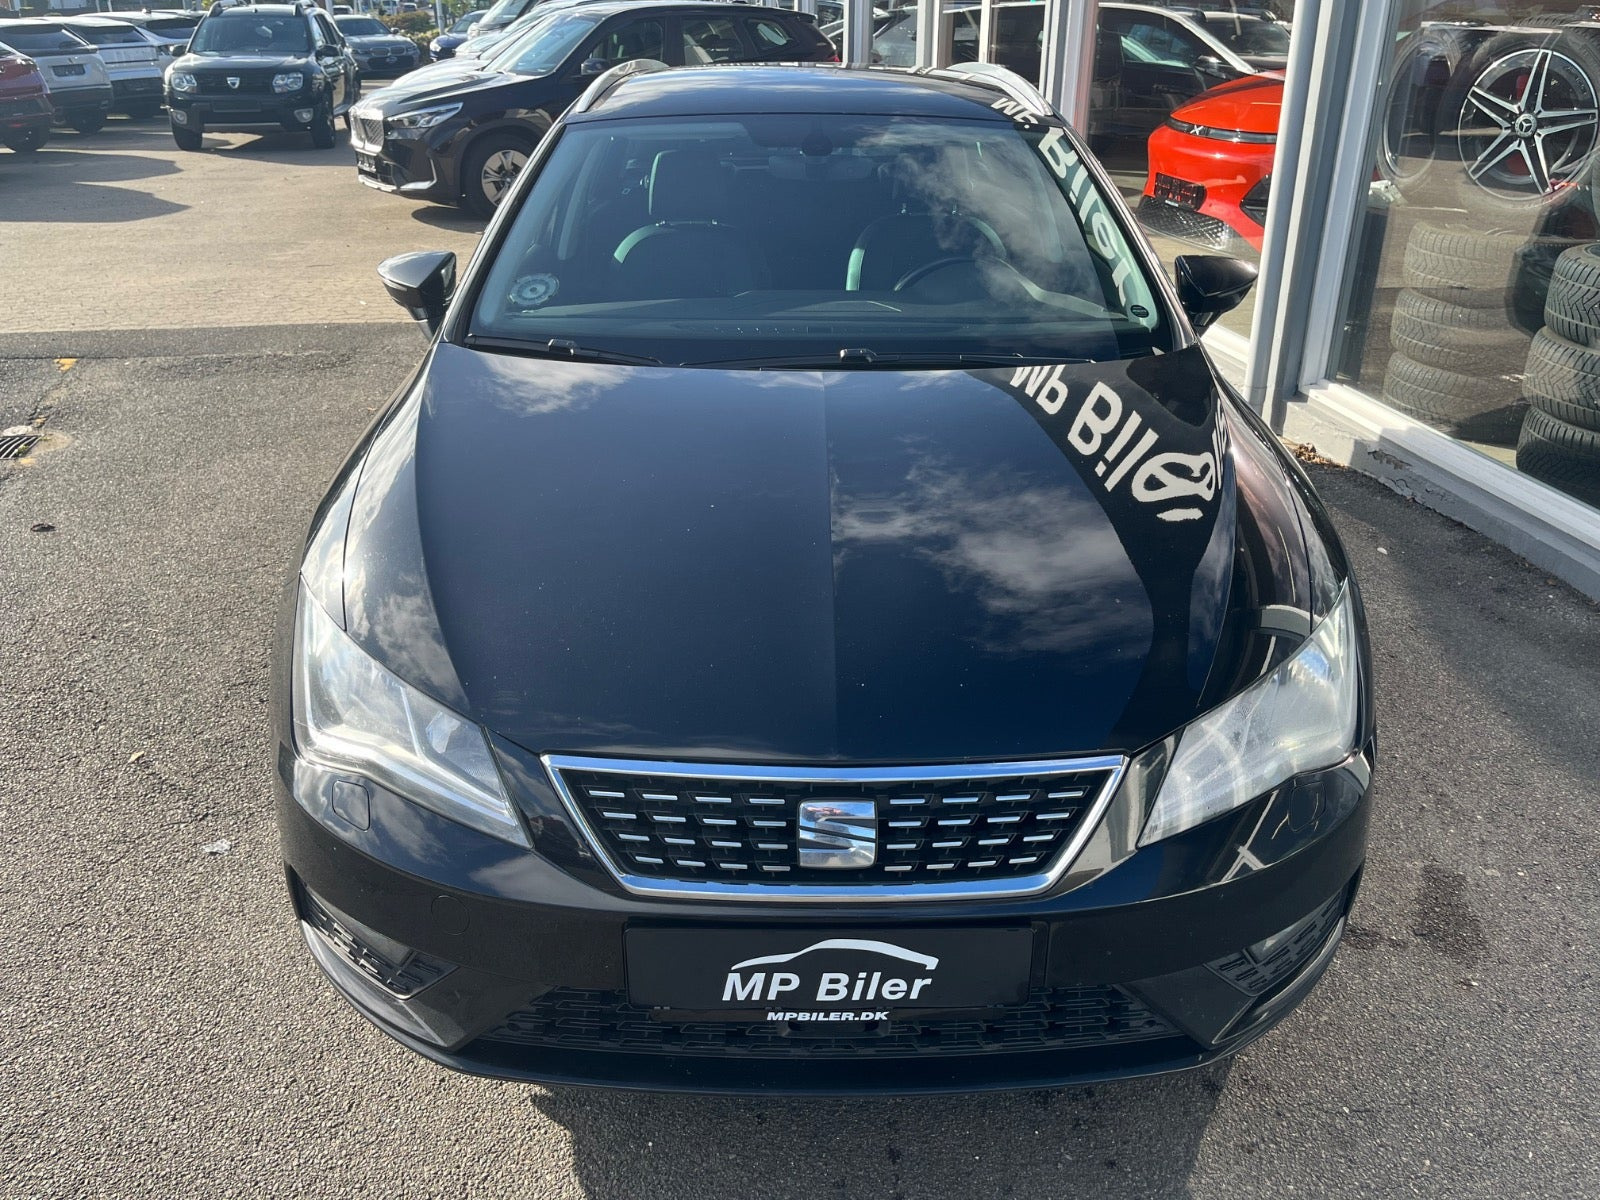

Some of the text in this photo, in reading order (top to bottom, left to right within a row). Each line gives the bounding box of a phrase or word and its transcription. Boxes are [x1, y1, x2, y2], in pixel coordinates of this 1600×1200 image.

[722, 972, 933, 1001] MP Biler
[766, 1011, 890, 1022] MPBILER.DK
